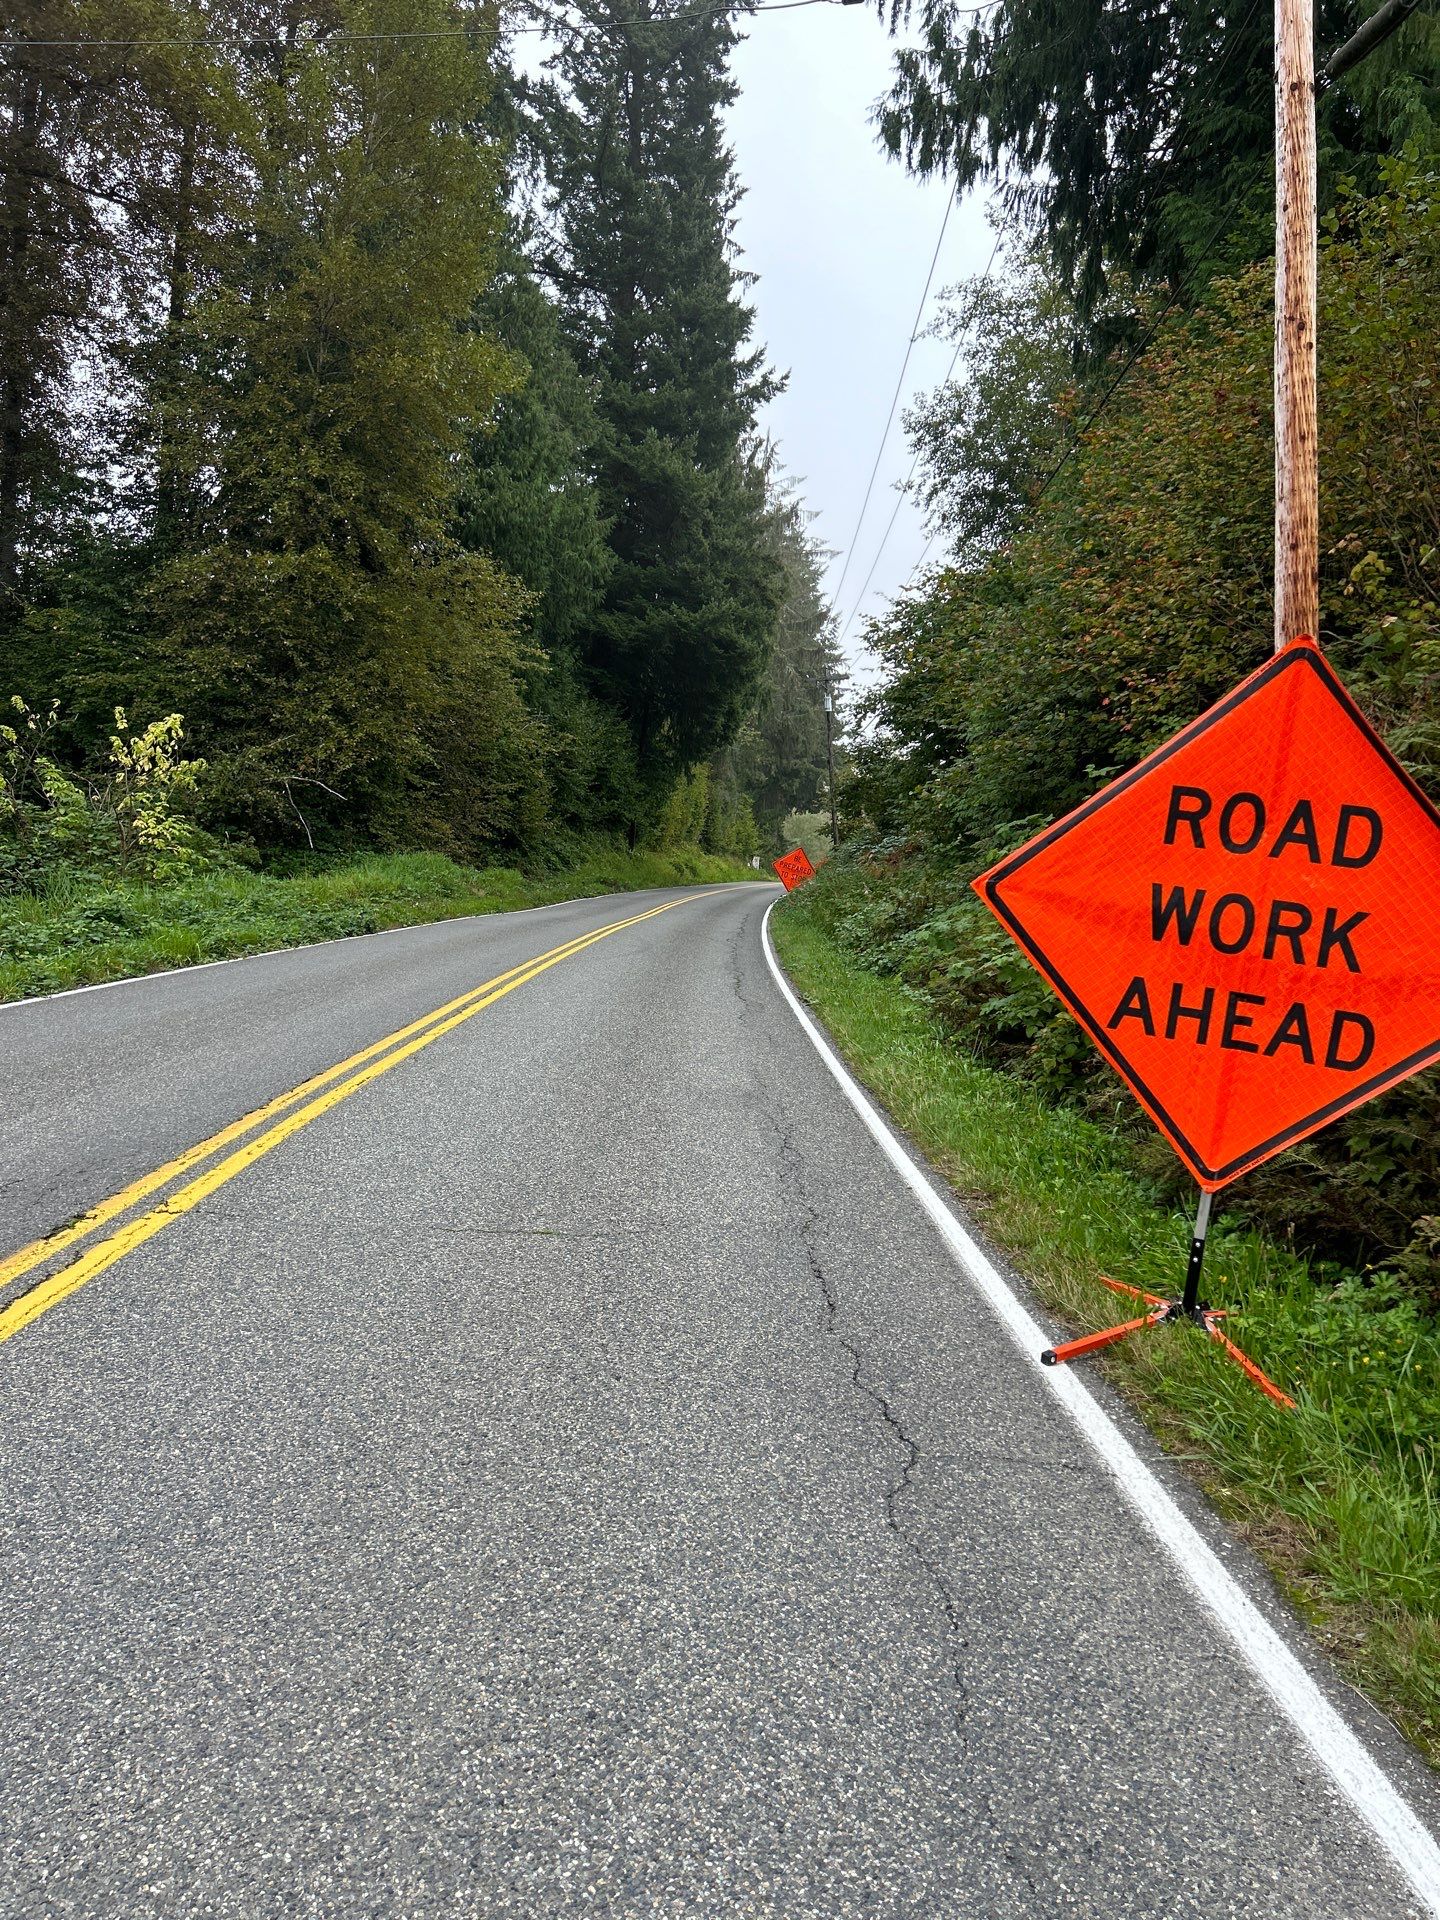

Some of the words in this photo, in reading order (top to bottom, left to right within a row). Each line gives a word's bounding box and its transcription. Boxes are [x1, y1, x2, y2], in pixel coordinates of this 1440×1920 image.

[780, 861, 811, 875] PREPARED
[1163, 785, 1382, 868] ROAD
[1151, 883, 1371, 973] WORK
[1107, 976, 1375, 1072] AHEAD
